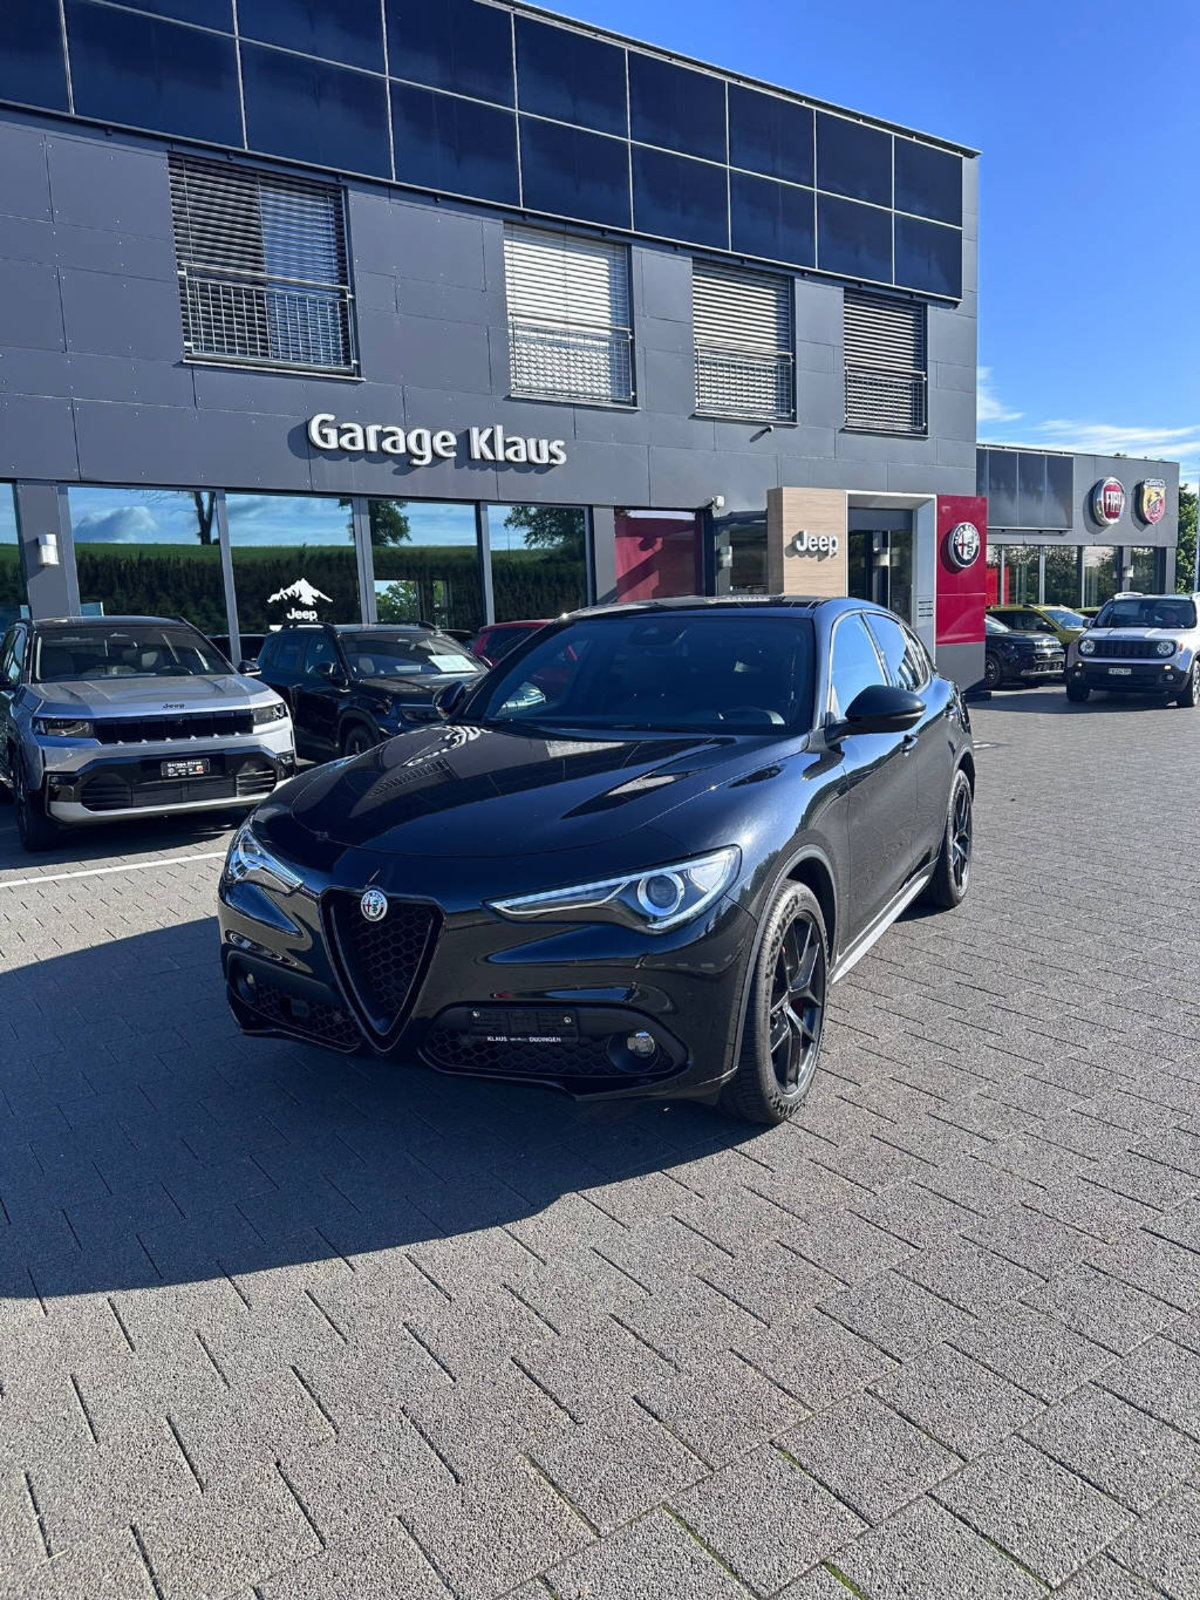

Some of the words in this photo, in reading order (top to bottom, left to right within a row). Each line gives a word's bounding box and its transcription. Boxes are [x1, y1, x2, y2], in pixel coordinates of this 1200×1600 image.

[309, 413, 457, 465] Garage
[469, 424, 567, 465] Klaus
[796, 530, 838, 556] Jeep
[286, 607, 318, 621] Jeep
